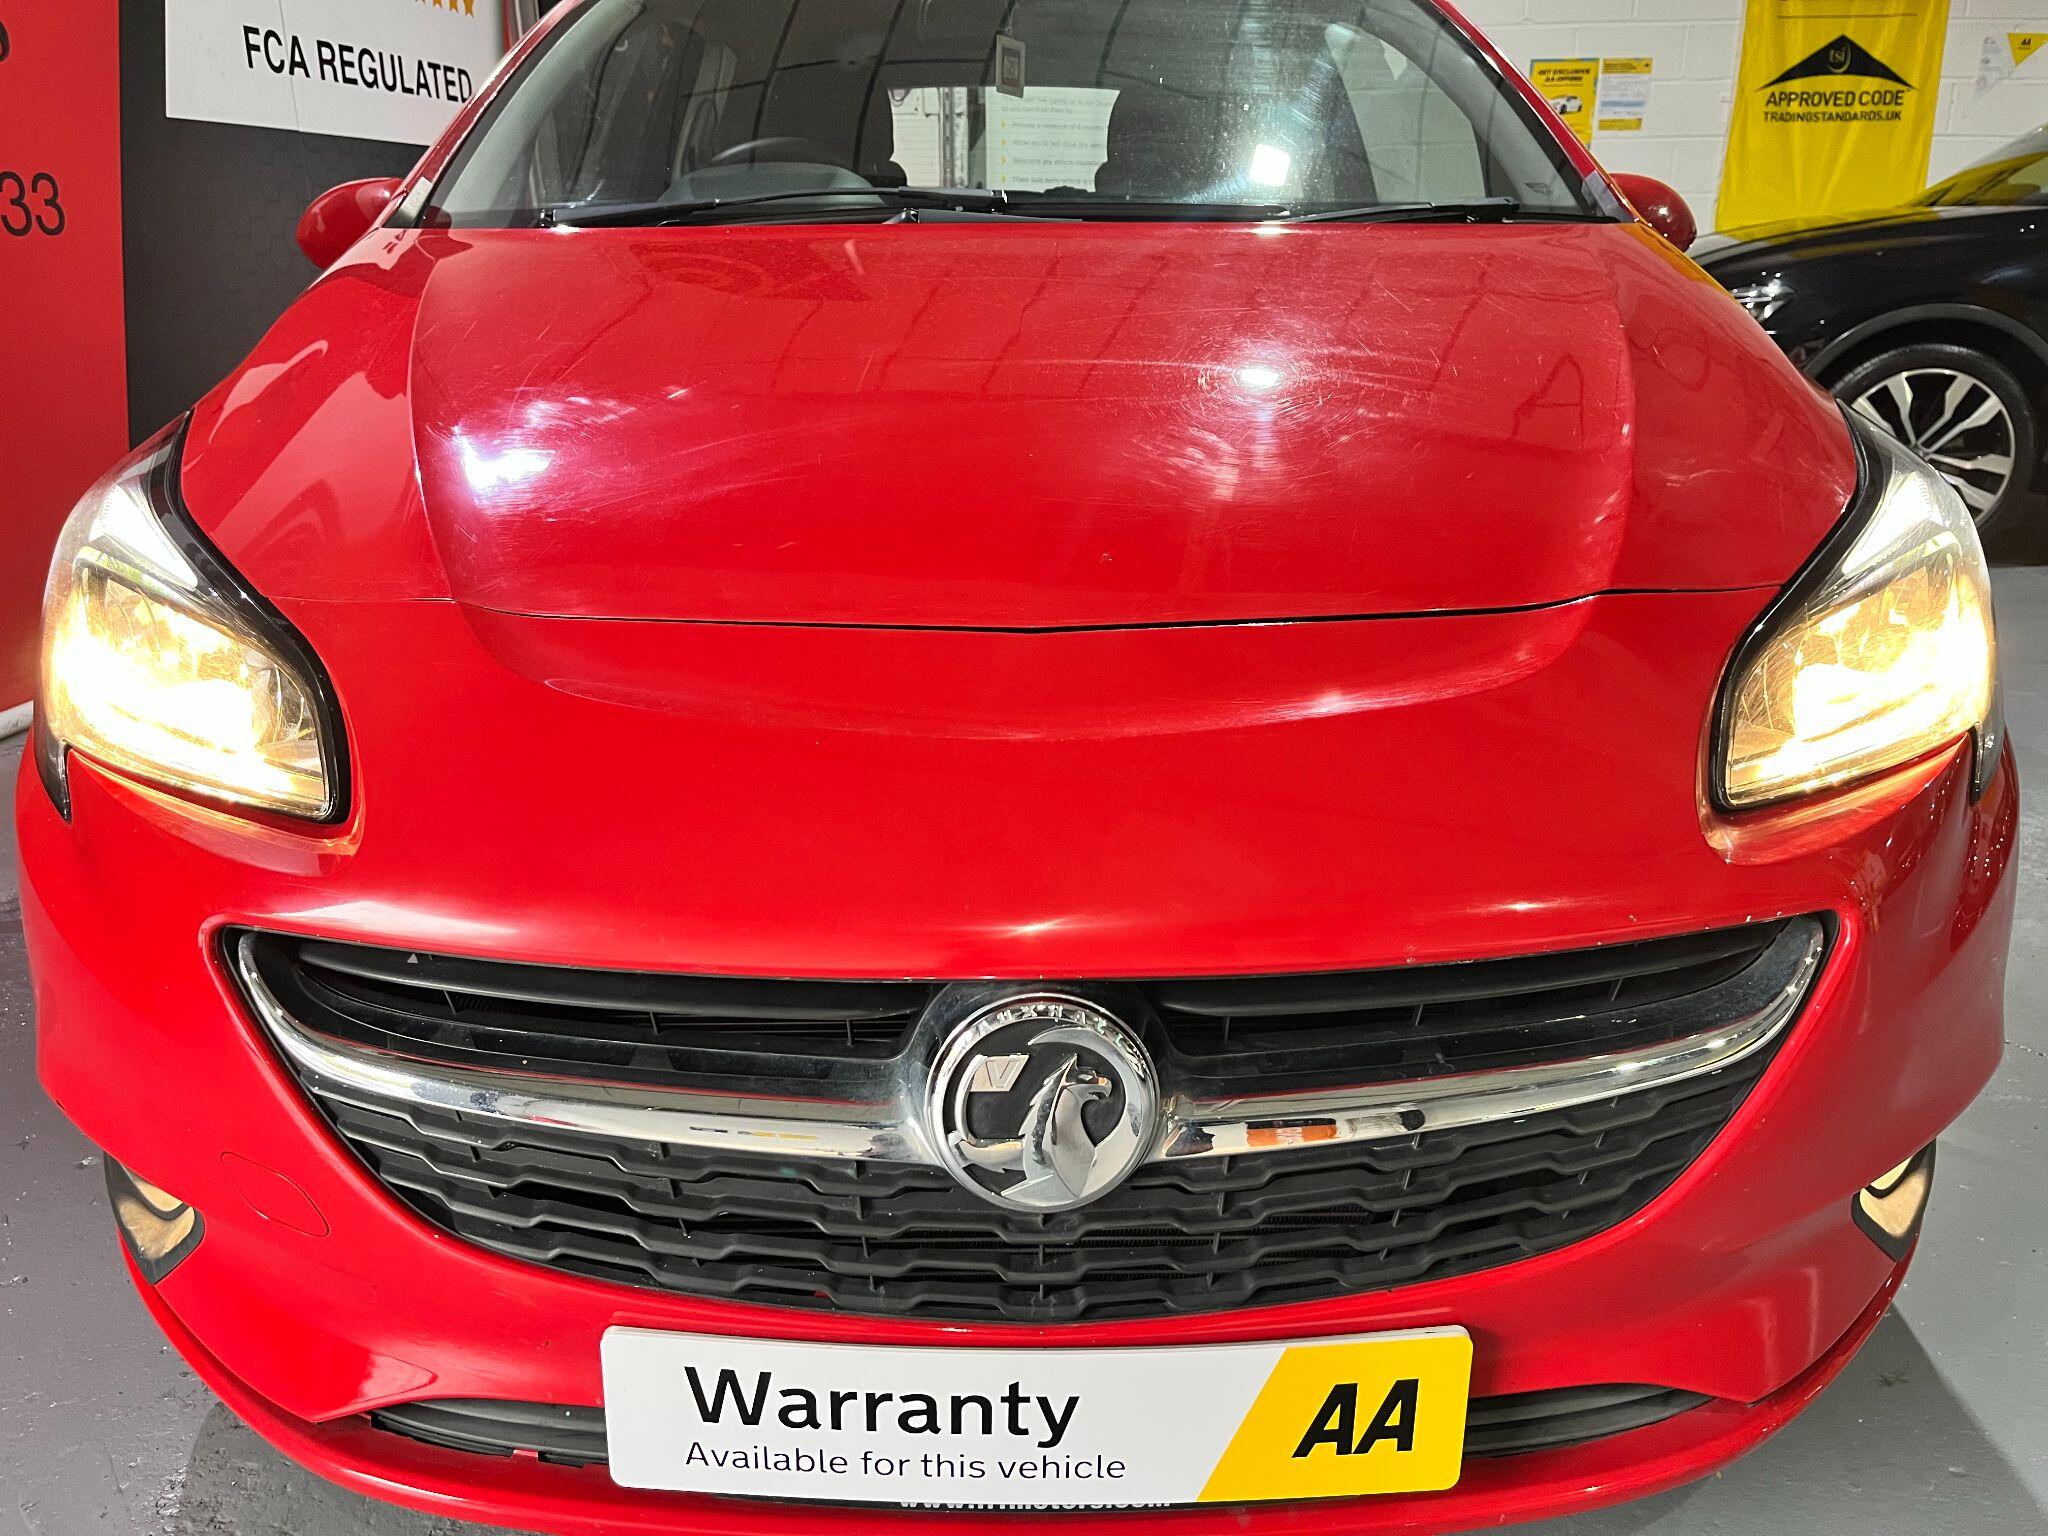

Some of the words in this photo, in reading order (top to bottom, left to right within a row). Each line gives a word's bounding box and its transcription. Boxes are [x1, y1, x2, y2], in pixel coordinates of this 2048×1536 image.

[243, 25, 311, 79] FCA
[316, 39, 473, 104] REGULATED
[1764, 110, 1902, 123] TRADINGSTANDARDS.UK
[1765, 91, 1855, 107] APPROVED
[1859, 90, 1904, 107] CODE
[684, 1365, 1080, 1449] Warranty
[1292, 1378, 1419, 1459] AA
[685, 1441, 848, 1474] Available
[860, 1450, 911, 1477] for
[920, 1453, 986, 1479] this
[997, 1454, 1126, 1479] vehicle
